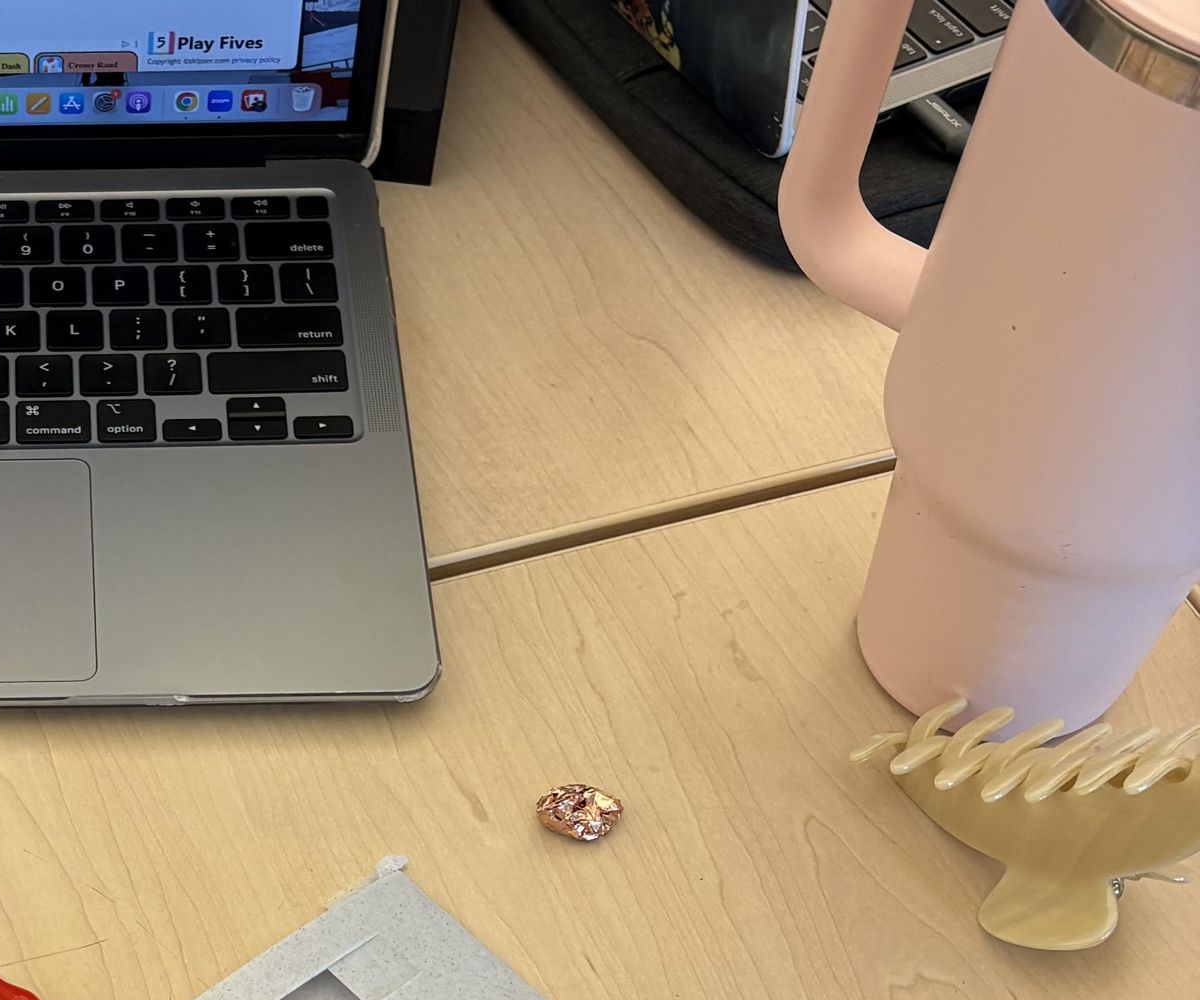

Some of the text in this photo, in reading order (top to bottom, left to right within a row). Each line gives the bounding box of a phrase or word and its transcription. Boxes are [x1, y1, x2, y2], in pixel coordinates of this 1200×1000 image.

[990, 5, 1011, 20] shift
[929, 9, 963, 37] caps lock
[156, 36, 264, 53] 5 Play Fives
[901, 43, 917, 55] tab
[1, 62, 22, 71] Dash
[20, 245, 32, 256] 9
[289, 244, 324, 252] delete
[52, 280, 65, 292] O
[114, 279, 126, 291] P
[5, 325, 17, 336] K
[69, 324, 80, 335] L
[297, 331, 333, 339] return
[311, 374, 338, 383] shift
[25, 425, 82, 435] command
[106, 424, 144, 434] option
